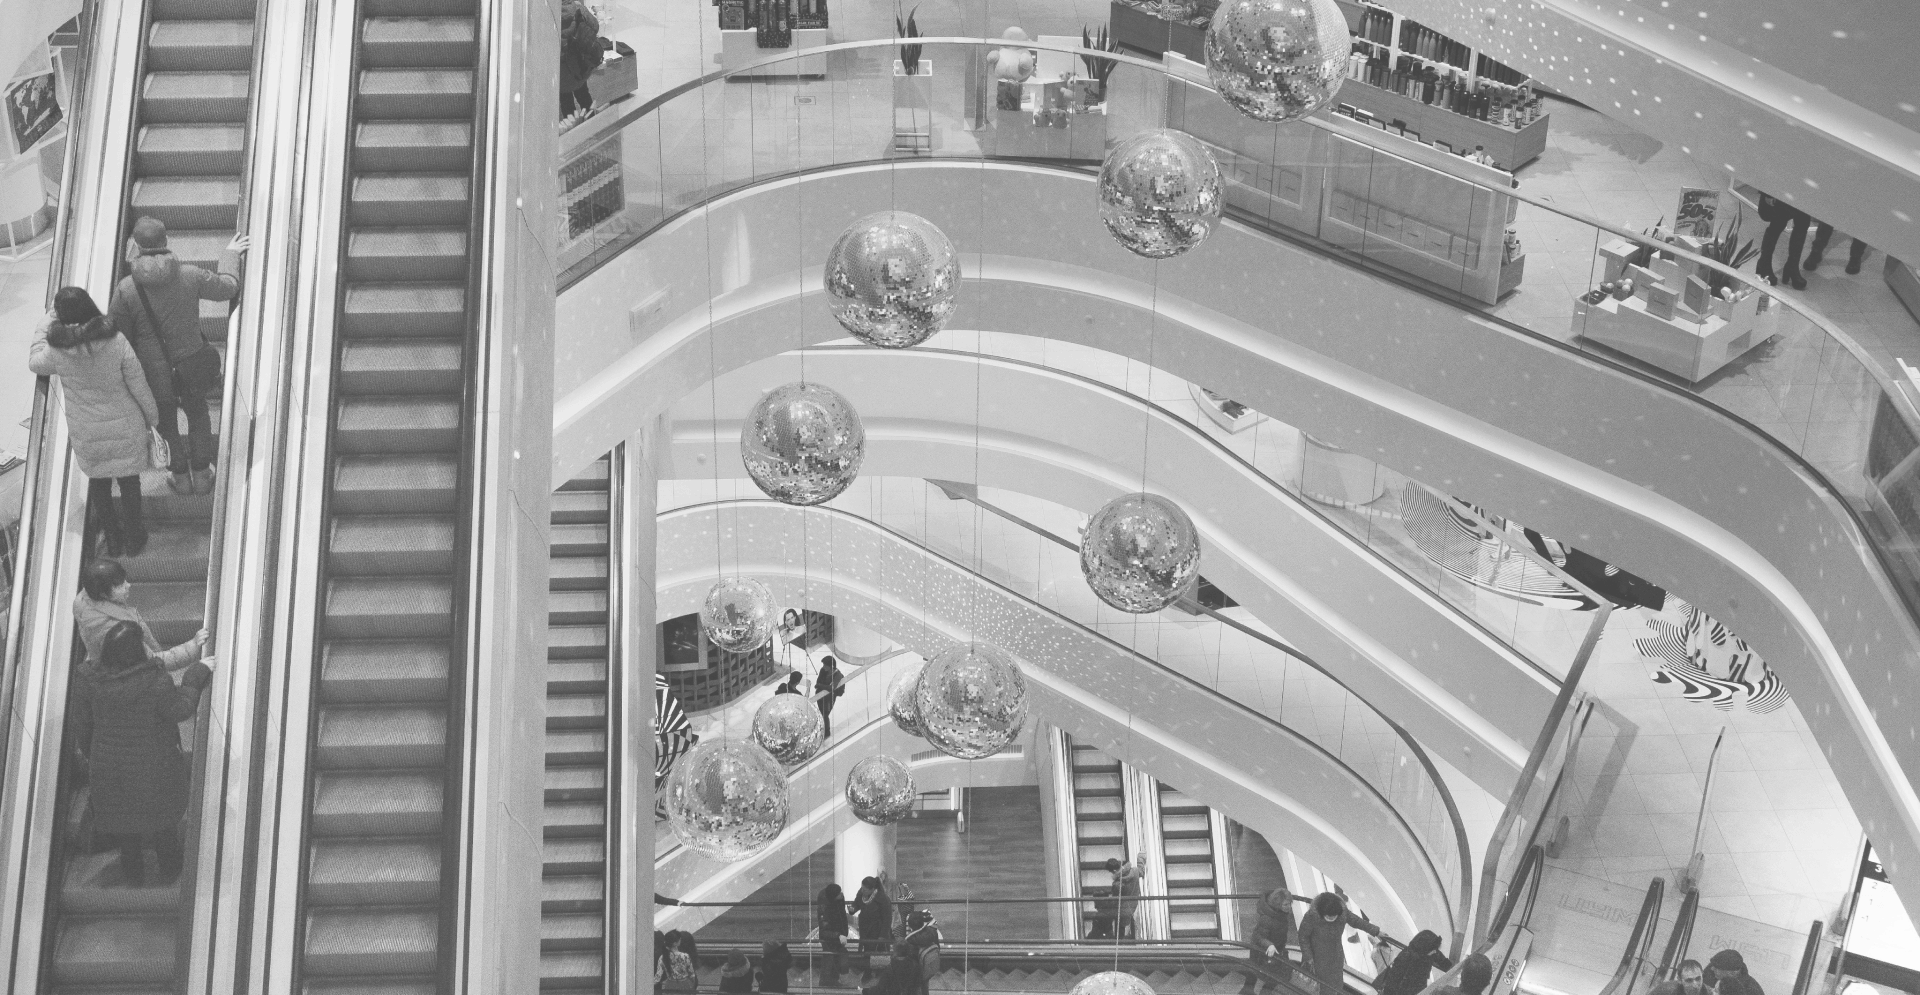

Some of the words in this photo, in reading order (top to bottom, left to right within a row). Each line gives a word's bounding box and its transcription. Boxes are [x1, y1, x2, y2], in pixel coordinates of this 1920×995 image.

[1677, 203, 1714, 221] 50%
[1875, 865, 1883, 873] 3
[1871, 882, 1878, 890] 2
